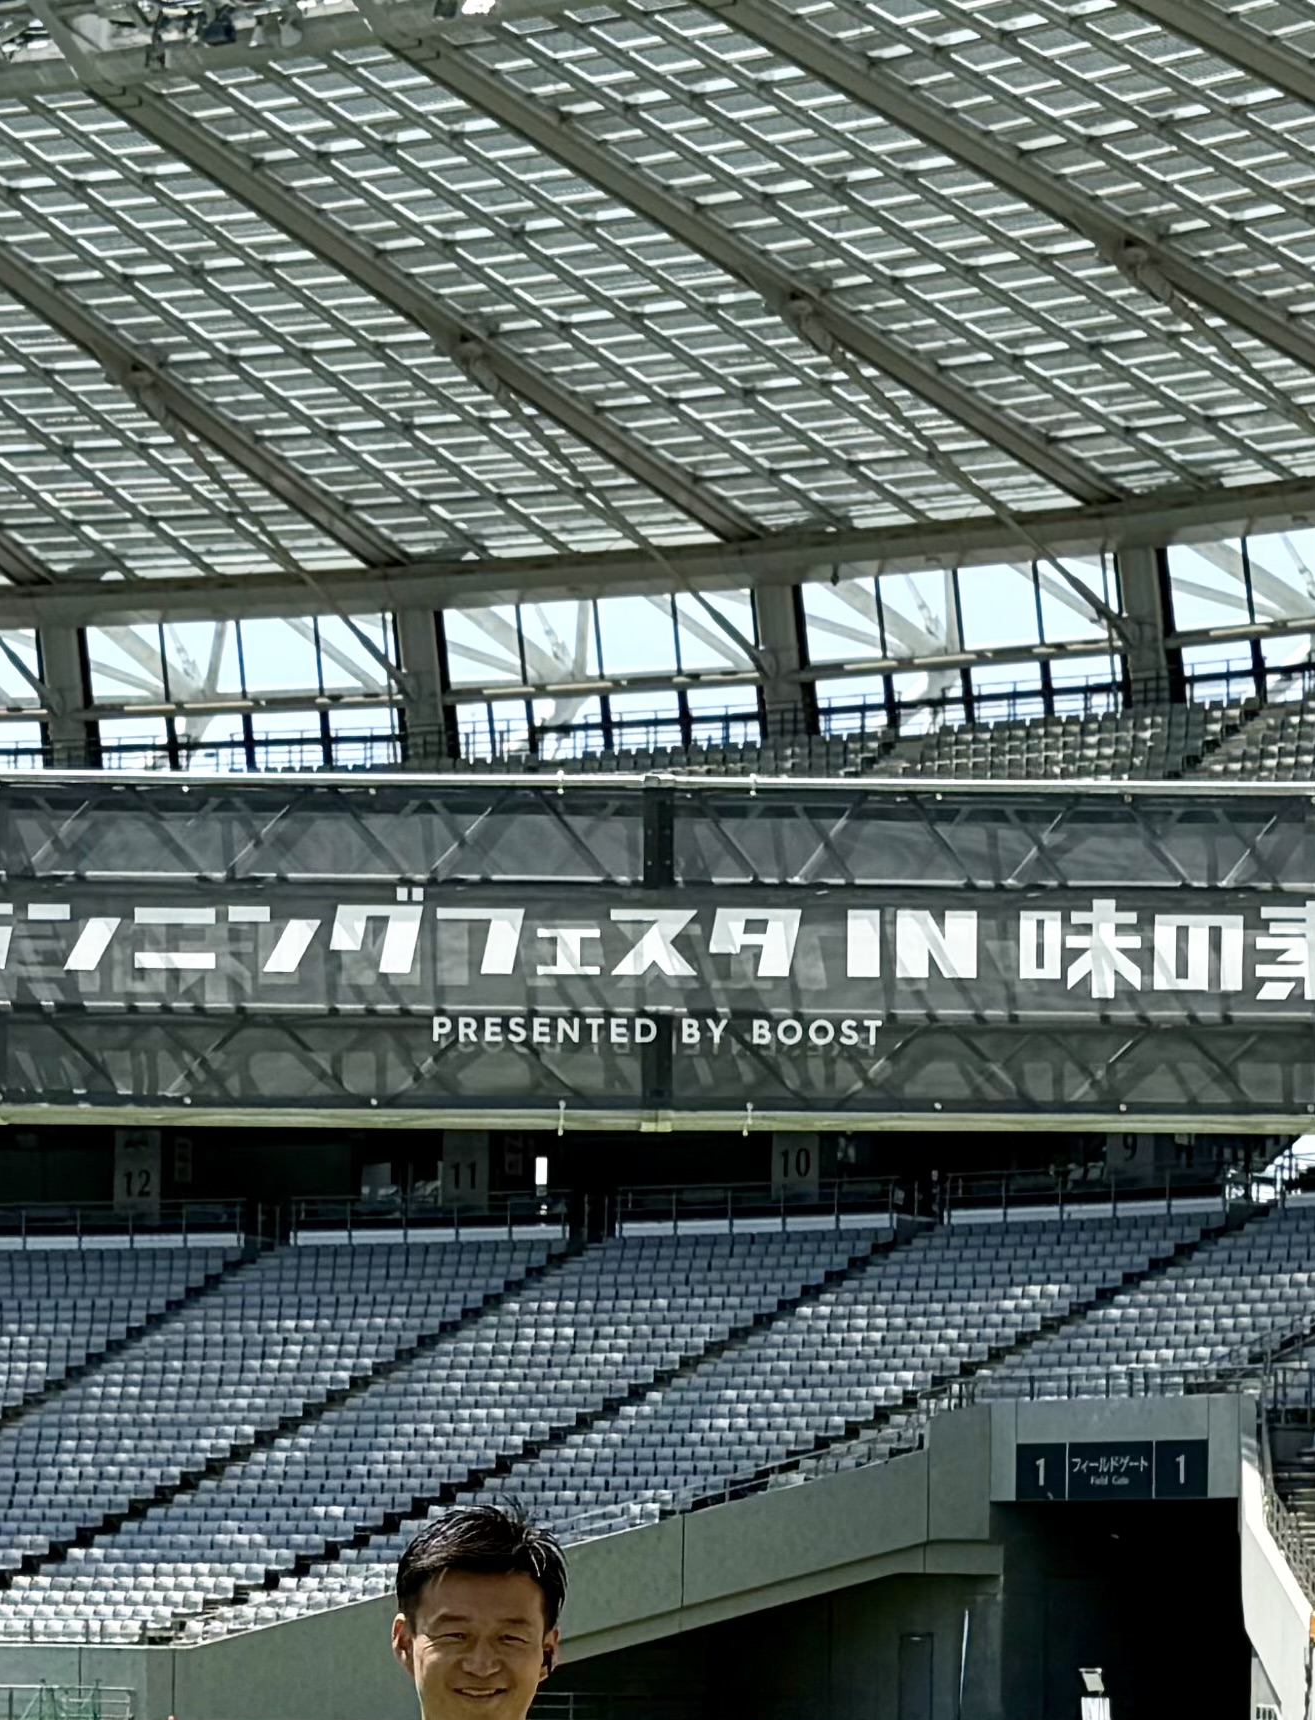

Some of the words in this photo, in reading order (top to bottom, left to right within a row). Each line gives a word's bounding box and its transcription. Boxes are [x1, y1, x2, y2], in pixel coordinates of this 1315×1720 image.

[846, 908, 977, 980] IN
[432, 1016, 657, 1044] PRESENTED
[681, 1018, 729, 1046] BY
[753, 1018, 884, 1047] BOOST
[452, 1161, 478, 1189] 11
[779, 1147, 811, 1176] 10
[122, 1170, 151, 1198] 12
[1035, 1457, 1045, 1487] 1
[1071, 1455, 1149, 1473] フィールドゲート
[1175, 1454, 1185, 1485] 1
